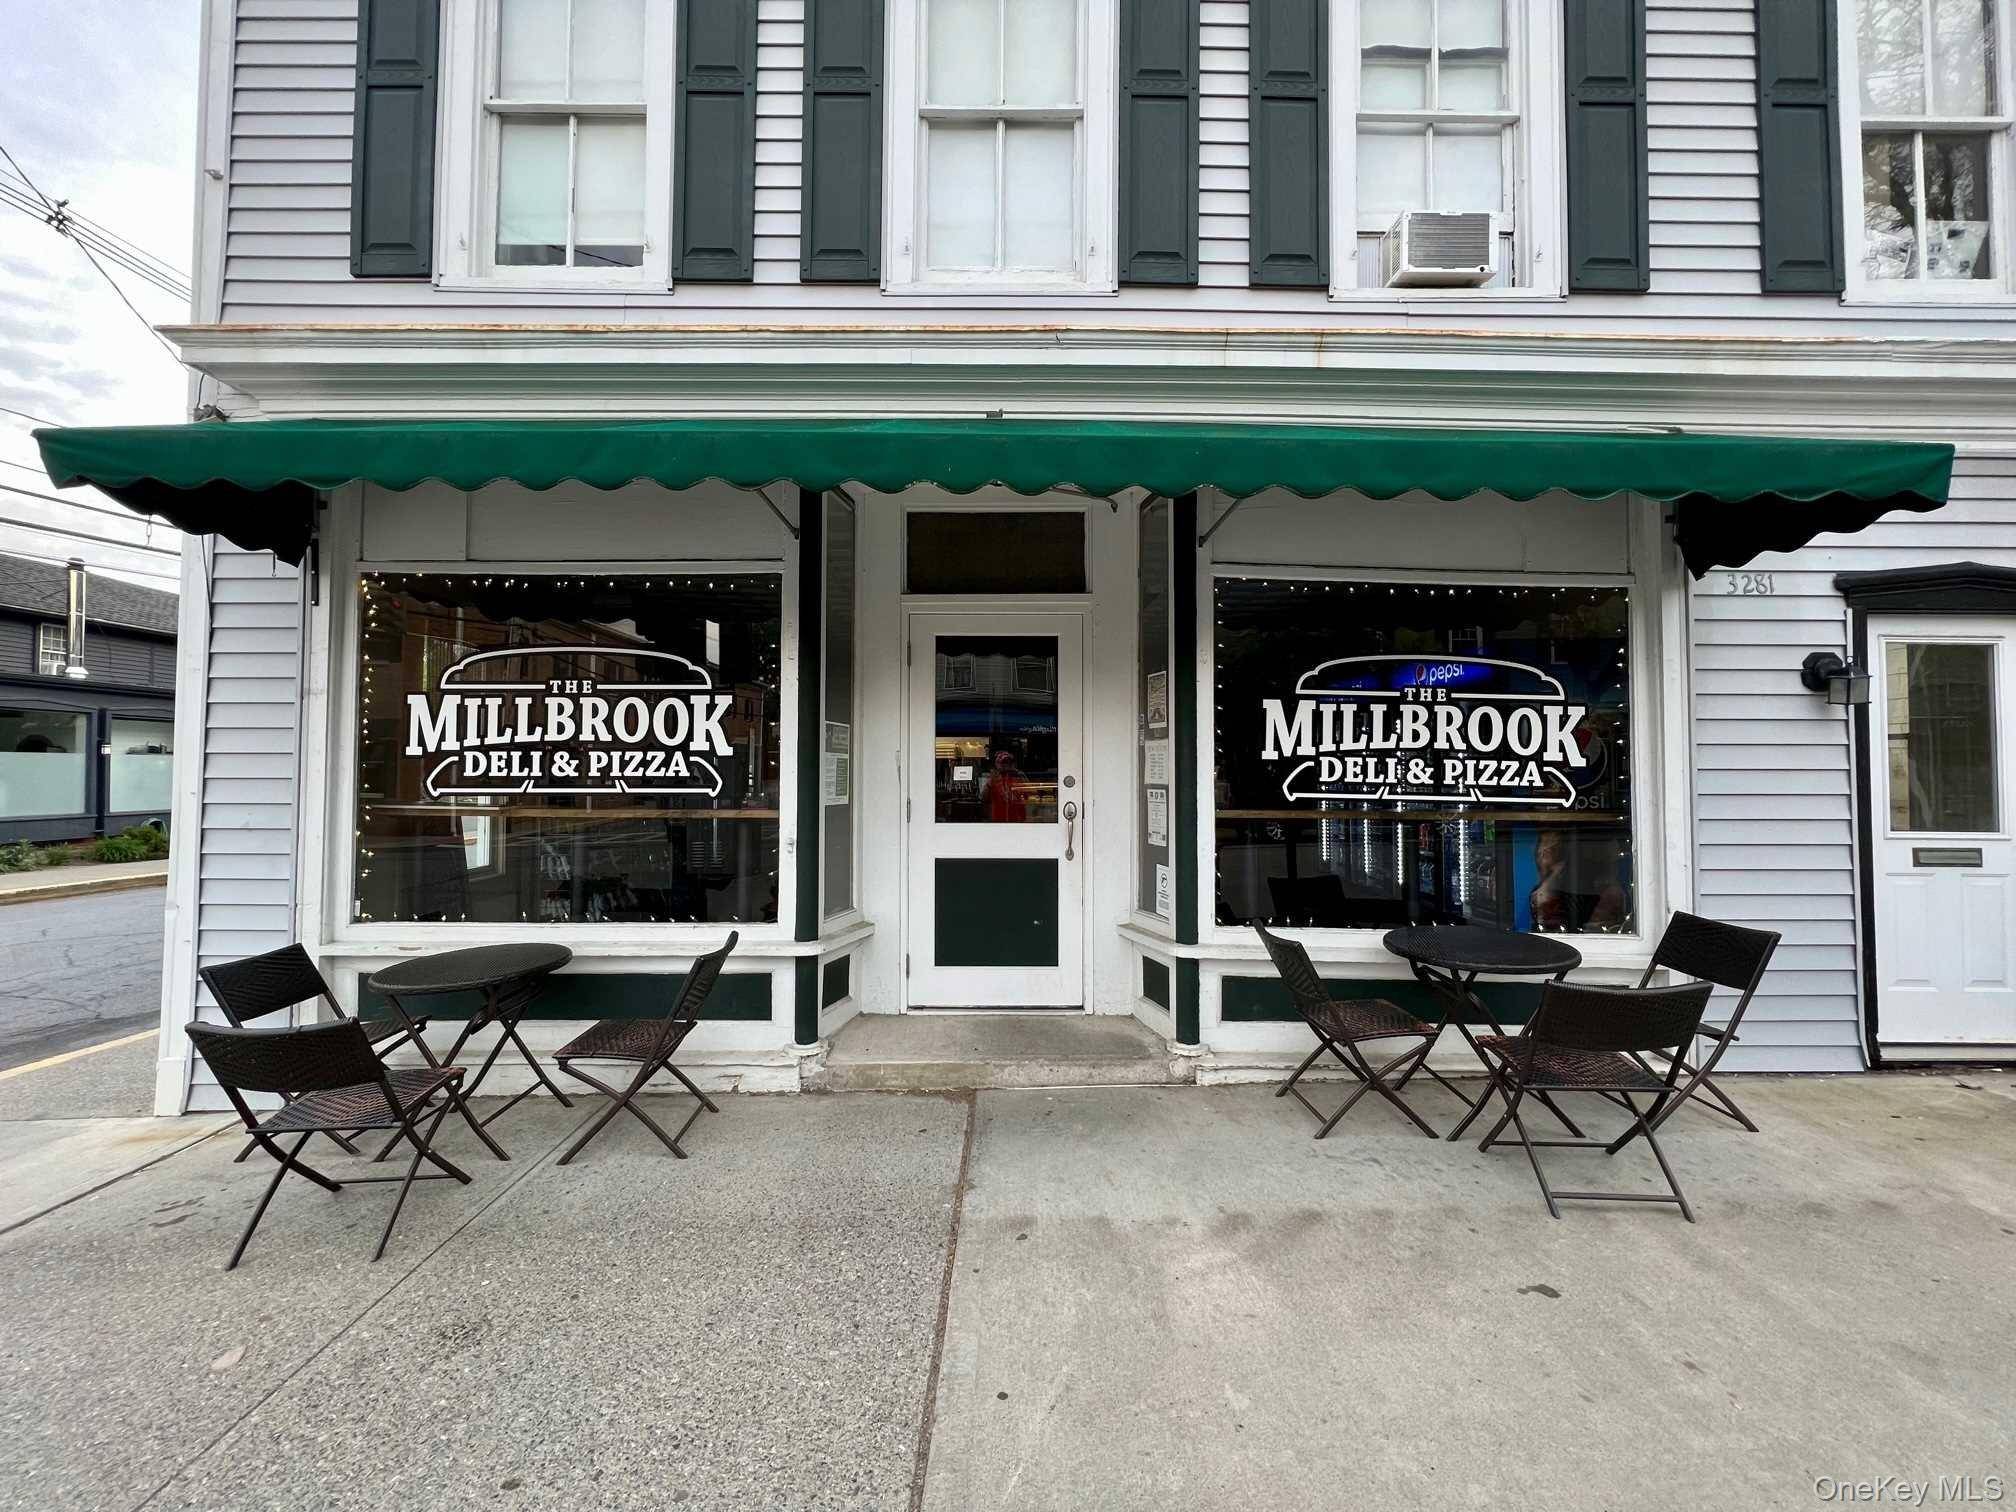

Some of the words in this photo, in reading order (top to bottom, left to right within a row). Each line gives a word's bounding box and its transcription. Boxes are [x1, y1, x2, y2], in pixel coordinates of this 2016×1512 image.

[1727, 572, 1776, 595] 3281
[549, 680, 593, 694] THE
[1429, 664, 1464, 686] pepsi
[1404, 687, 1447, 702] THE
[405, 694, 734, 756] MILLBROOK
[1261, 699, 1587, 767] MILLBROOK
[463, 751, 543, 777] DELI
[551, 751, 580, 777] &
[588, 751, 691, 777] PIZZA
[1319, 756, 1398, 784] DELI
[1406, 758, 1434, 785] &
[1443, 759, 1545, 787] PIZZA
